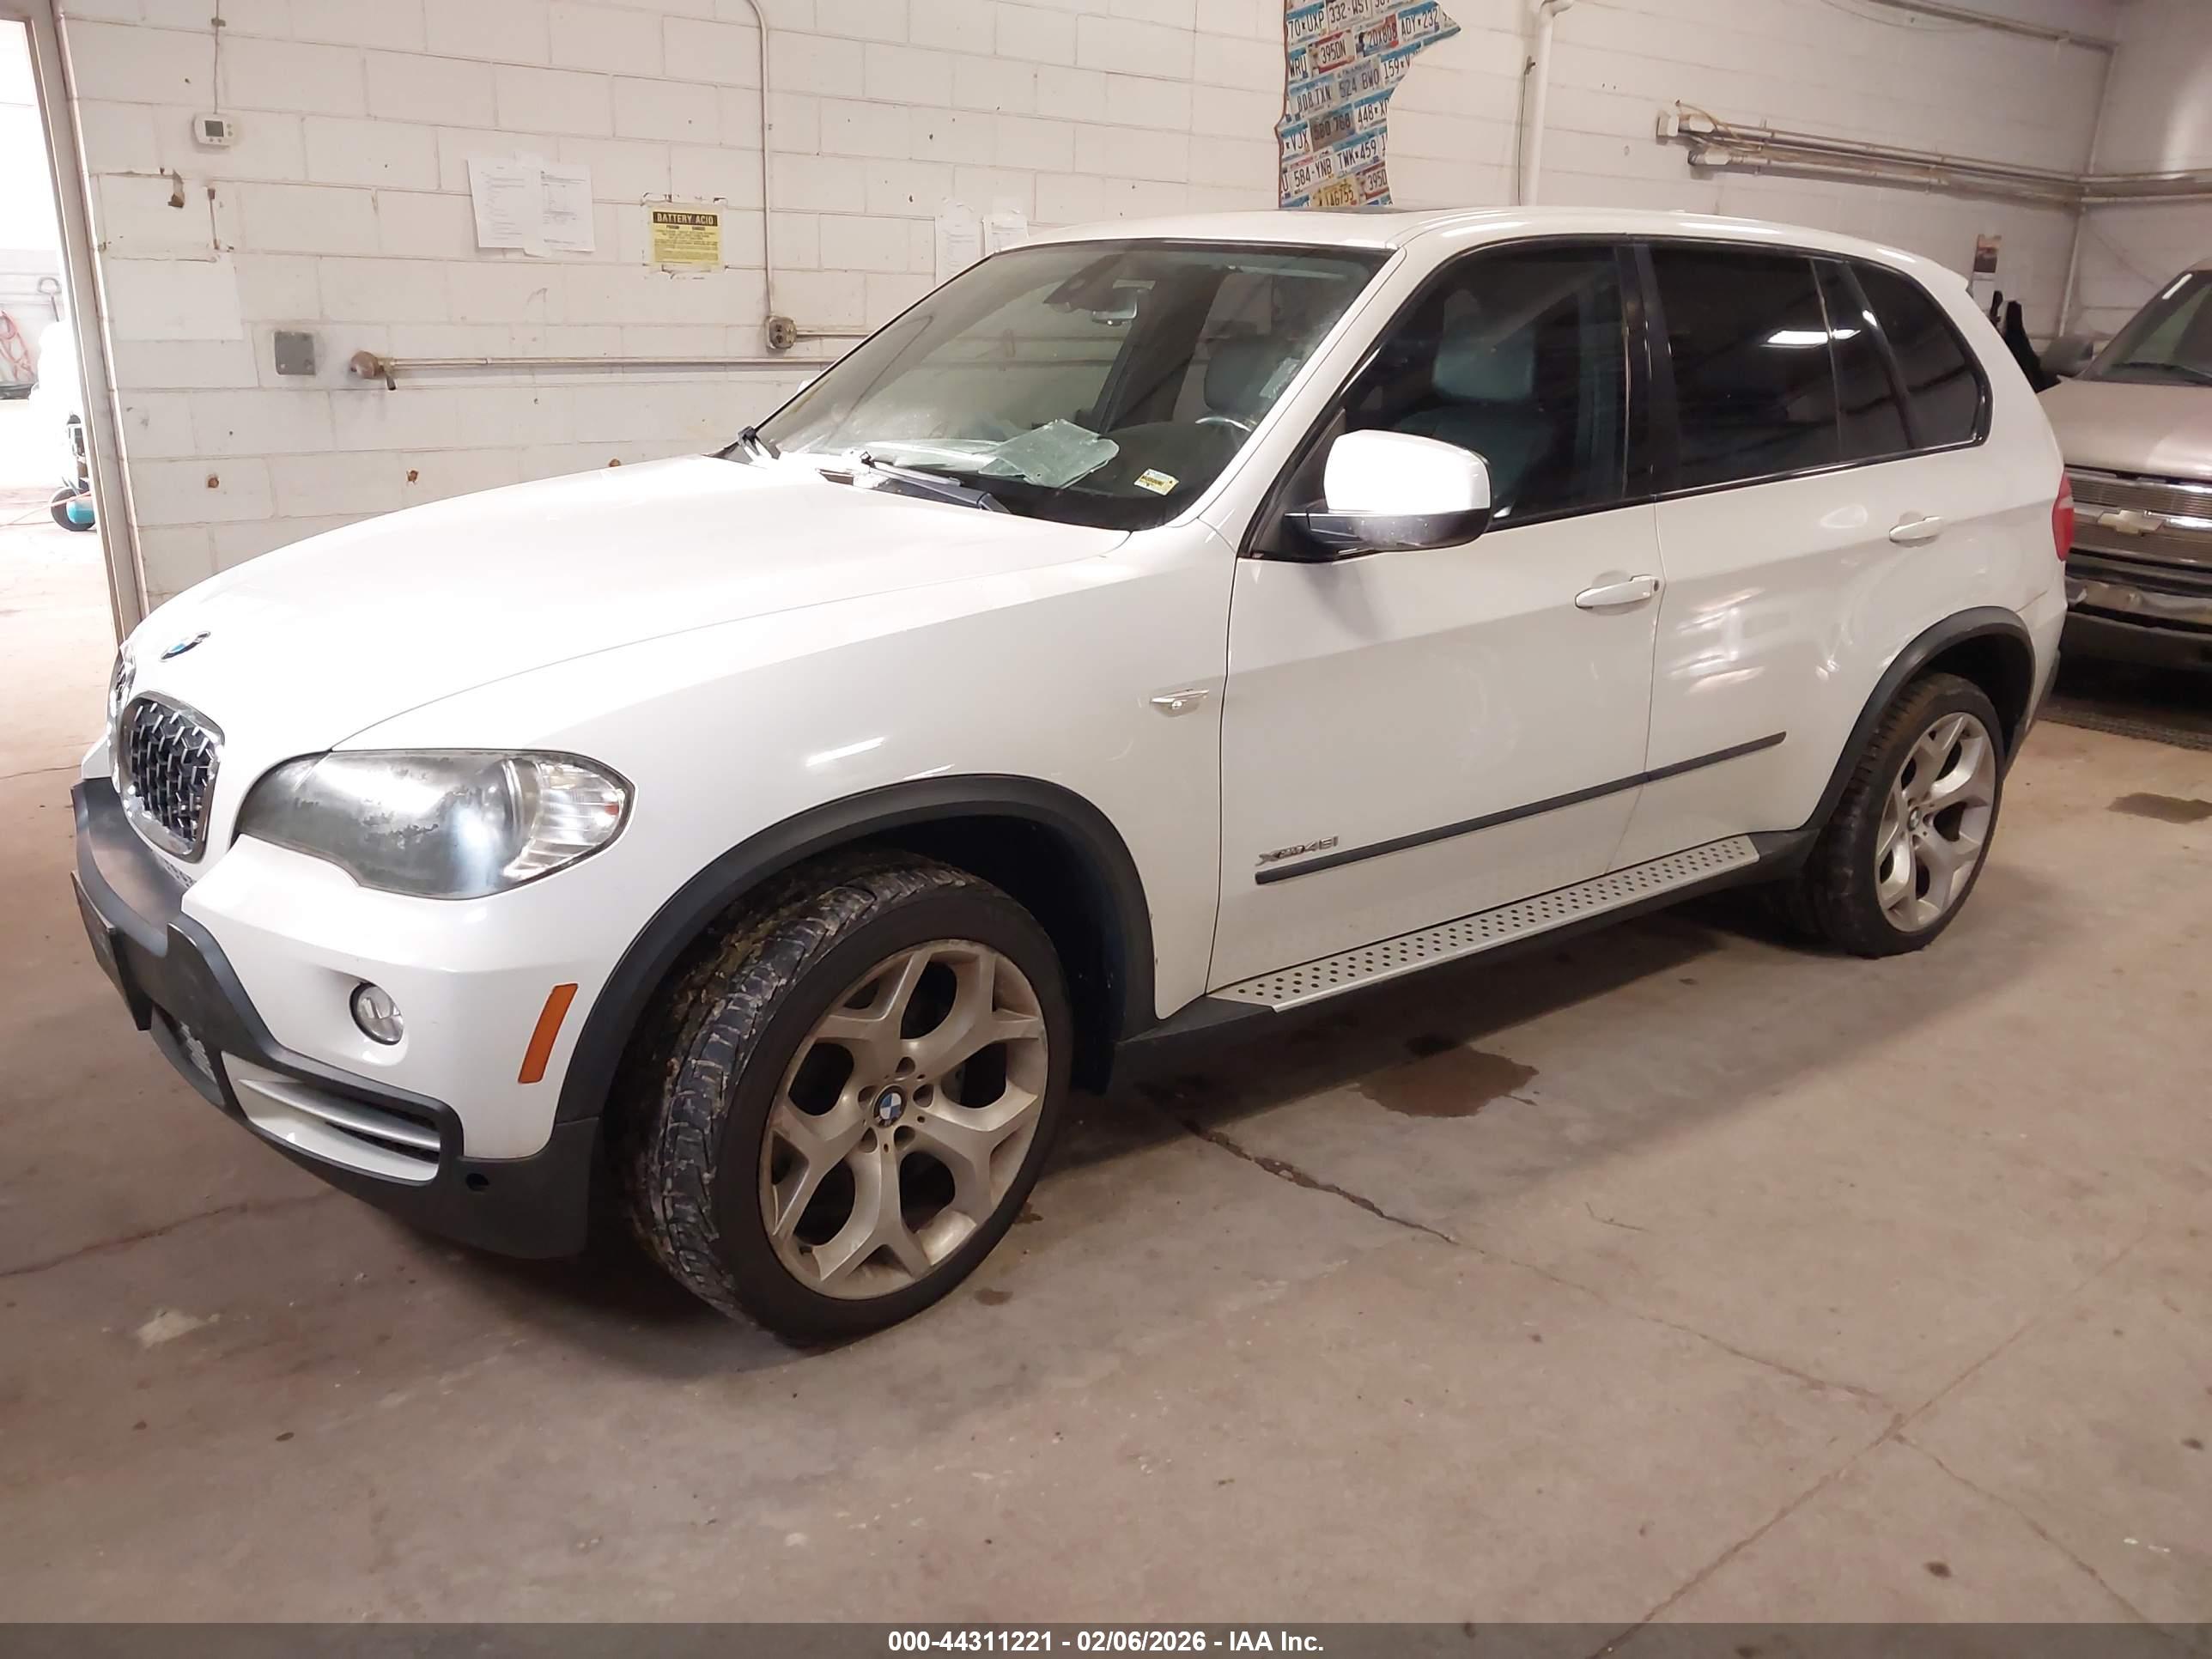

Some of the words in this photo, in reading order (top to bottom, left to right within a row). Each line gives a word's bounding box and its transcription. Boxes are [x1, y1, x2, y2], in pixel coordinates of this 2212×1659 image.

[1307, 12, 1324, 32] UXP
[1358, 104, 1374, 125] 448
[1360, 140, 1377, 161] 459
[657, 213, 692, 223] BATTERY
[696, 215, 714, 225] ACID
